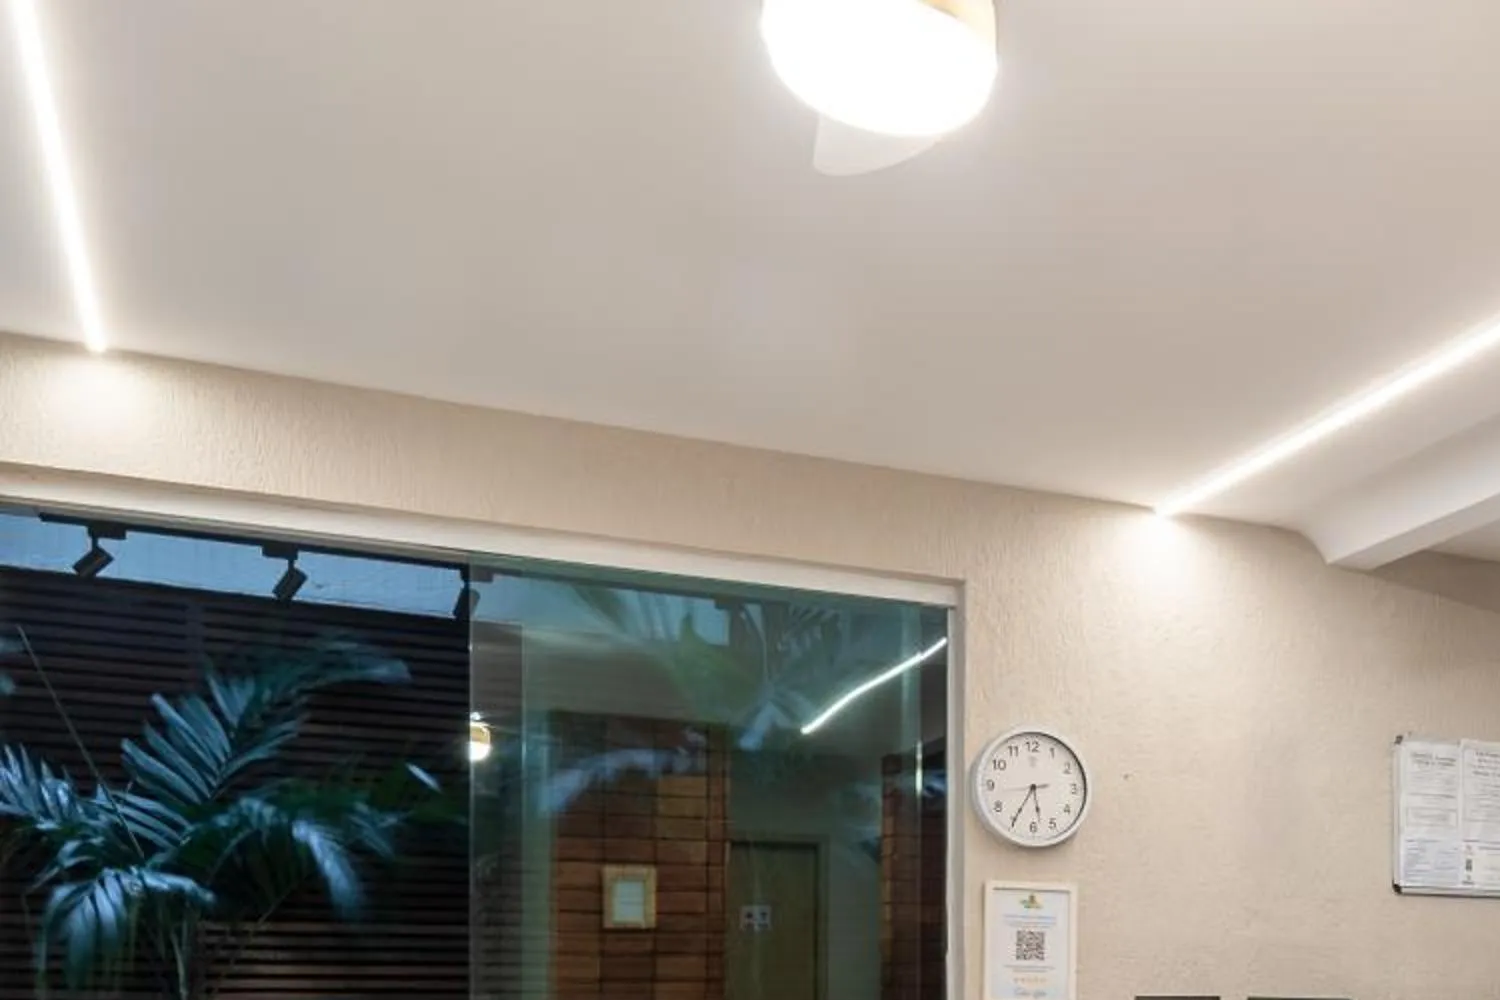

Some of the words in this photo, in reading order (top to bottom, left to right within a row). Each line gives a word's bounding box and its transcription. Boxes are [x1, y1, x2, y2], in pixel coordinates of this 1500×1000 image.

[1008, 745, 1019, 757] 11
[1025, 740, 1040, 753] 12
[1049, 747, 1055, 759] 1
[992, 759, 1006, 771] 10
[1063, 762, 1071, 775] 2
[986, 779, 995, 791] 9
[1071, 783, 1077, 795] 3
[994, 800, 1003, 812] 8
[1063, 803, 1071, 814] 4
[1029, 821, 1038, 833] 6
[1048, 817, 1057, 830] 5
